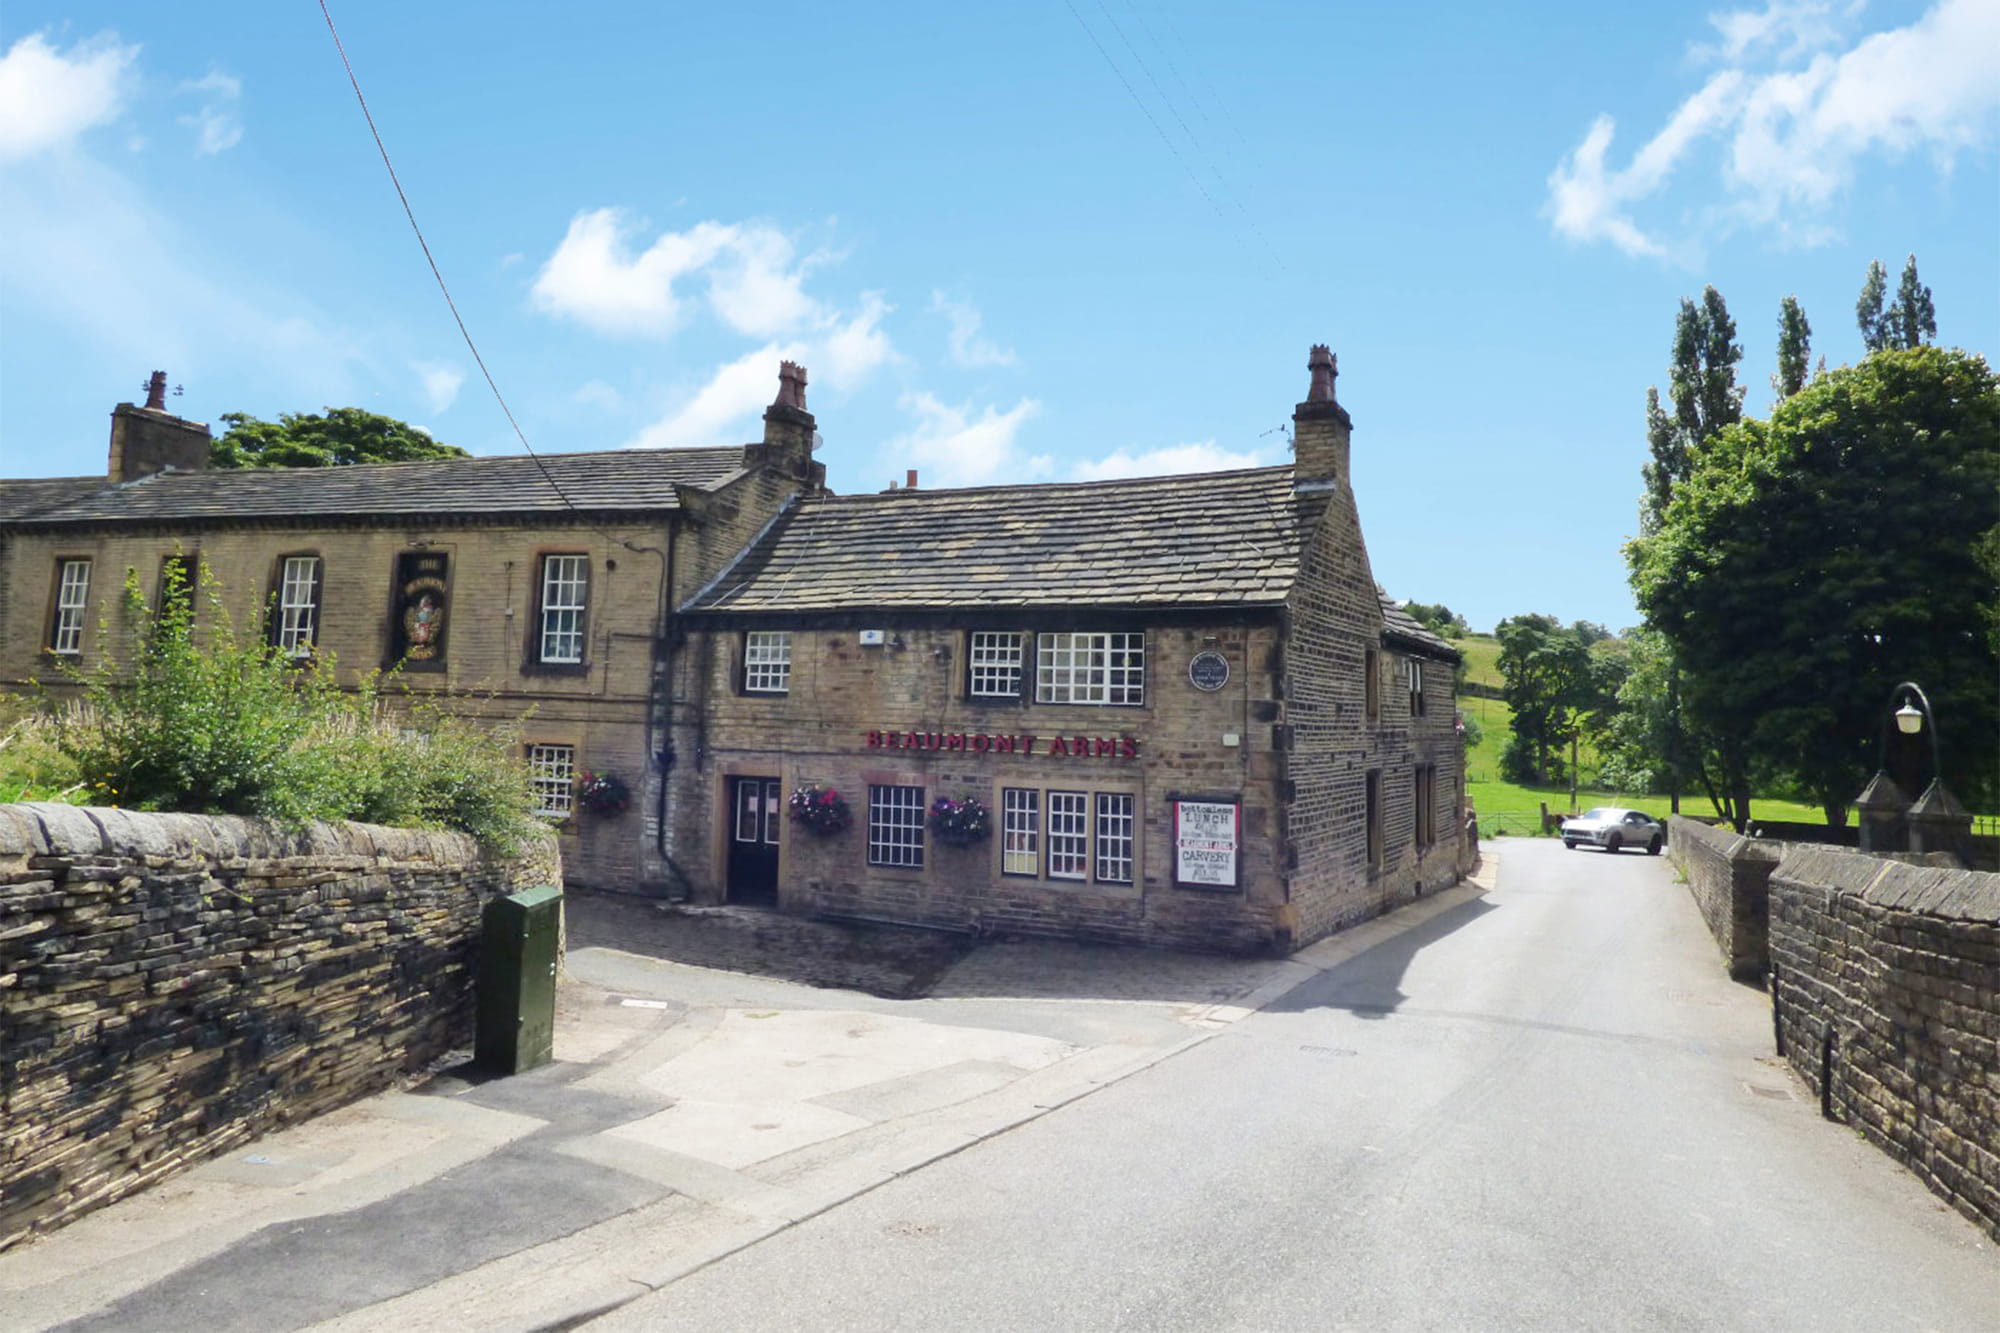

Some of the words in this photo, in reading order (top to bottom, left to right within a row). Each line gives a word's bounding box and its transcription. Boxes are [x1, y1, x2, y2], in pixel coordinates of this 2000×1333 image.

[866, 730, 1037, 755] BEAUMONT
[1050, 736, 1138, 758] ARMS
[1185, 812, 1228, 824] LUNCH
[1183, 850, 1230, 863] CARVERY
